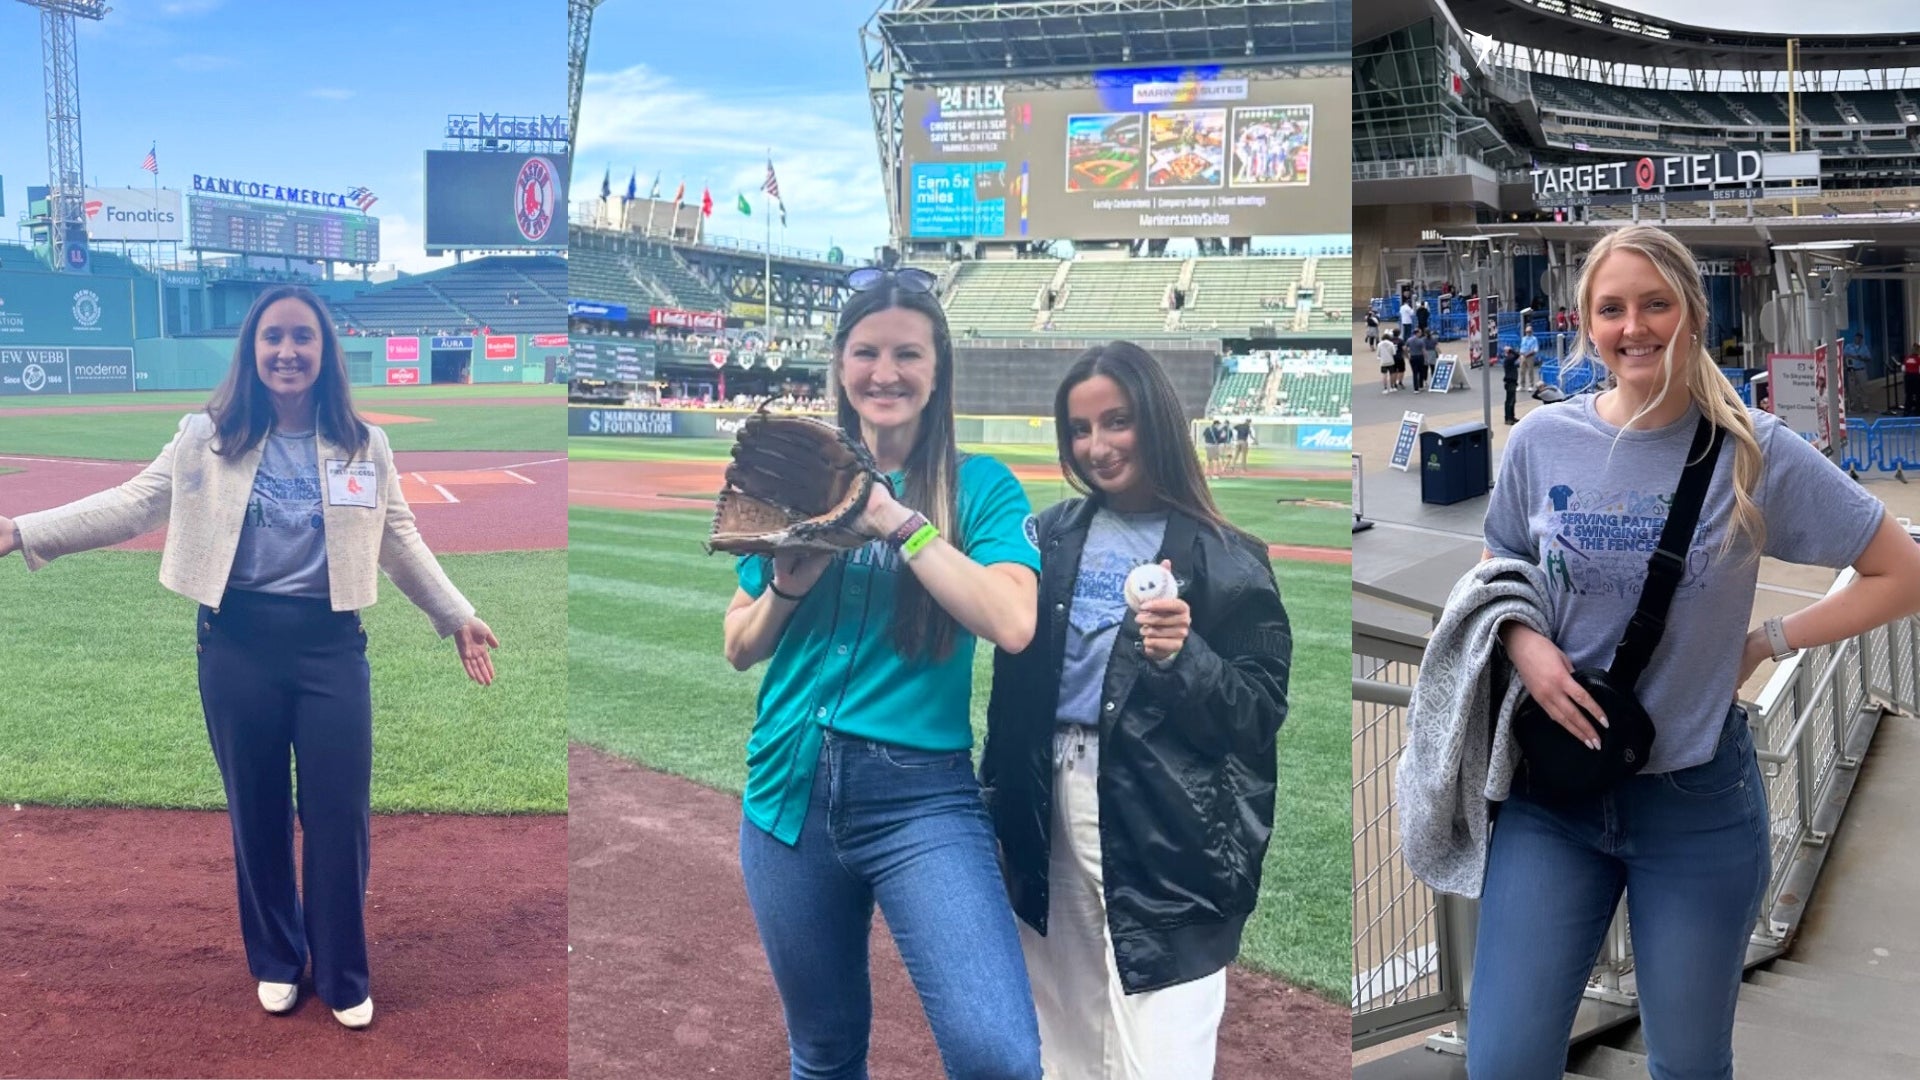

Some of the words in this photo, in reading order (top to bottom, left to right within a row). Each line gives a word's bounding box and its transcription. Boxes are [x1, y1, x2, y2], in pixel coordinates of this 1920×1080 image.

[1200, 84, 1243, 95] SUITES
[966, 84, 1005, 109] FLEX
[1530, 161, 1628, 195] TARGET
[1663, 150, 1762, 186] FIELD
[917, 174, 950, 190] Earn
[193, 174, 244, 195] BANK
[249, 182, 270, 198] OF
[274, 186, 347, 208] AMERICA
[917, 190, 954, 204] miles
[1713, 190, 1737, 199] BEST
[1739, 188, 1758, 198] BUY
[1881, 189, 1907, 197] FIELD
[1632, 194, 1643, 203] US
[1647, 193, 1666, 202] BANK
[106, 206, 175, 224] Fanatics
[1513, 244, 1540, 256] GATE
[1698, 261, 1731, 276] ATE
[166, 276, 201, 286] ABIOMED
[26, 350, 65, 364] WEBB
[74, 364, 127, 376] moderna
[1777, 403, 1796, 411] Target
[604, 411, 647, 422] MARINERS
[650, 412, 672, 422] CARE
[604, 421, 672, 434] FOUNDATION
[1560, 513, 1619, 526] SERVING
[1563, 525, 1572, 537] &
[1573, 525, 1649, 539] SWINGING
[1578, 538, 1604, 550] THE
